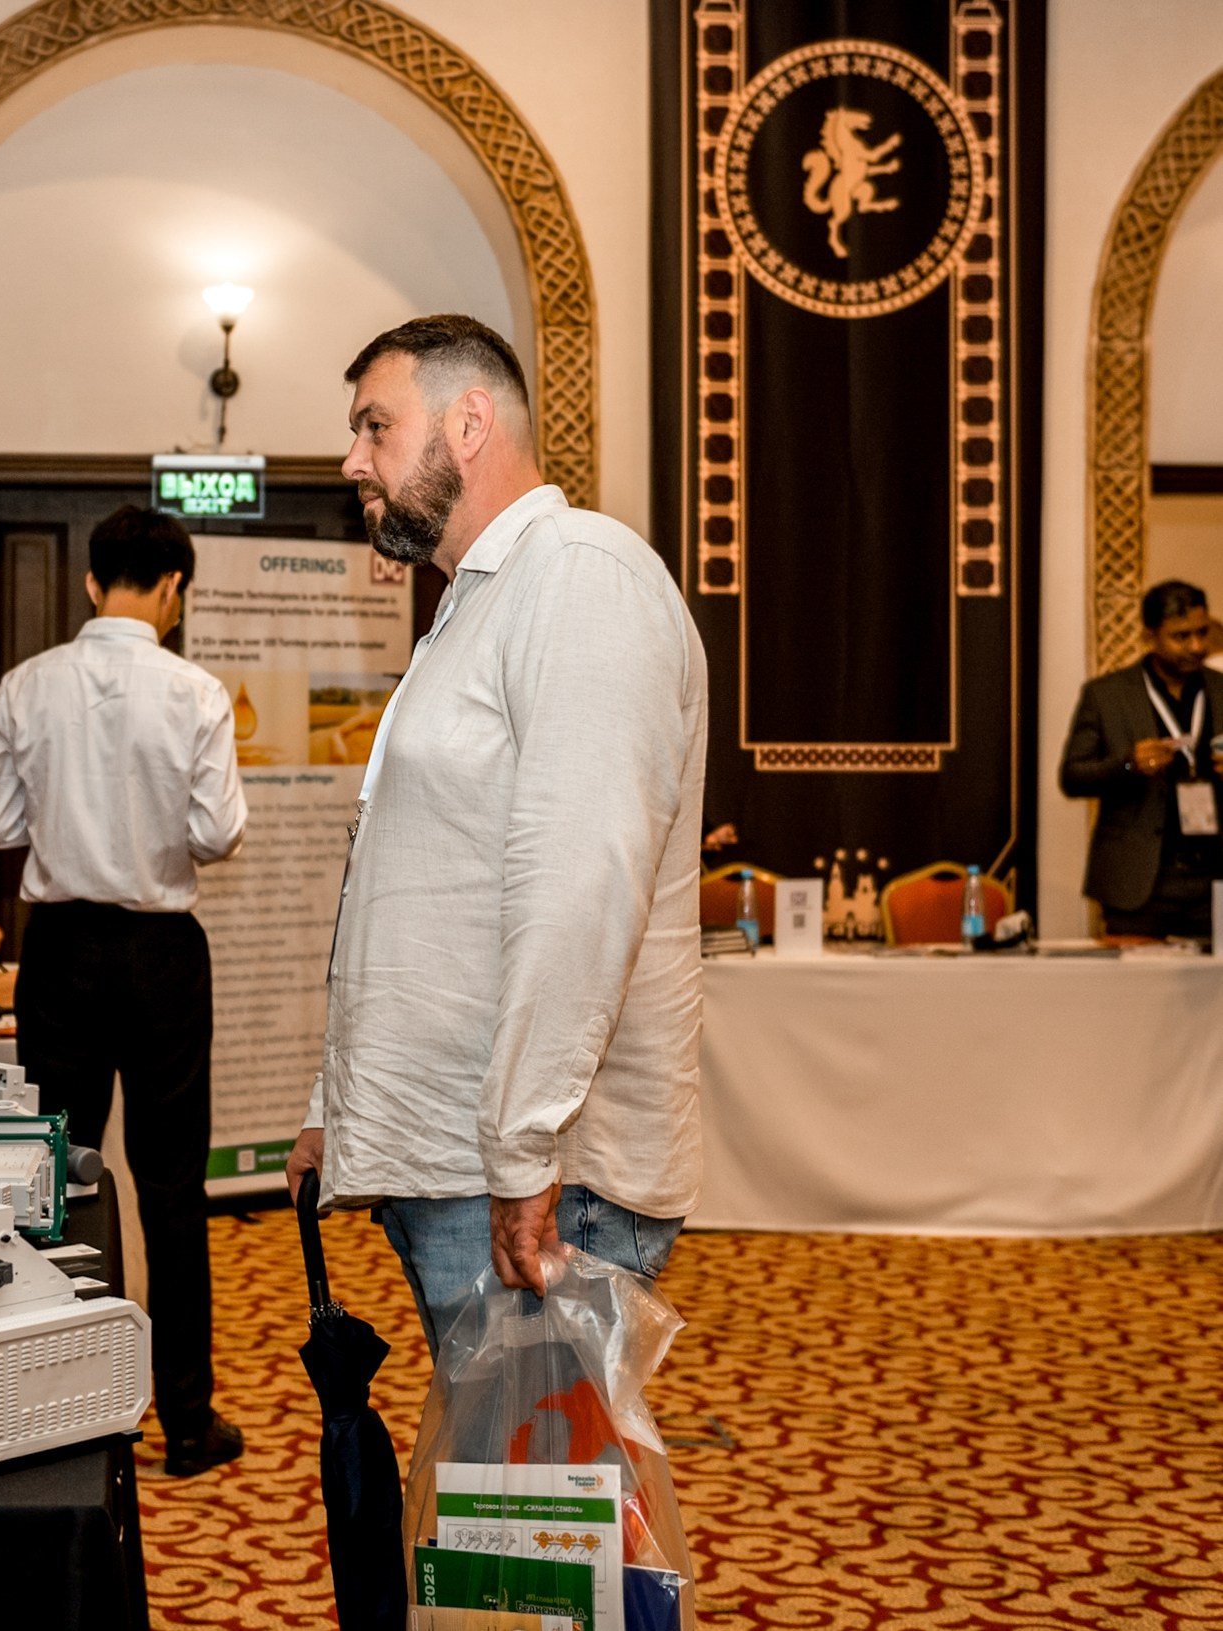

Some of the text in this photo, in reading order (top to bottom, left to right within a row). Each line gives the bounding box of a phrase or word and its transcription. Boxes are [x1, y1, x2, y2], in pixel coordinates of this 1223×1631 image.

[160, 472, 256, 502] ВЫХОД
[182, 497, 233, 514] EXIT
[260, 555, 346, 575] OFFERINGS
[424, 1563, 436, 1606] 2025
